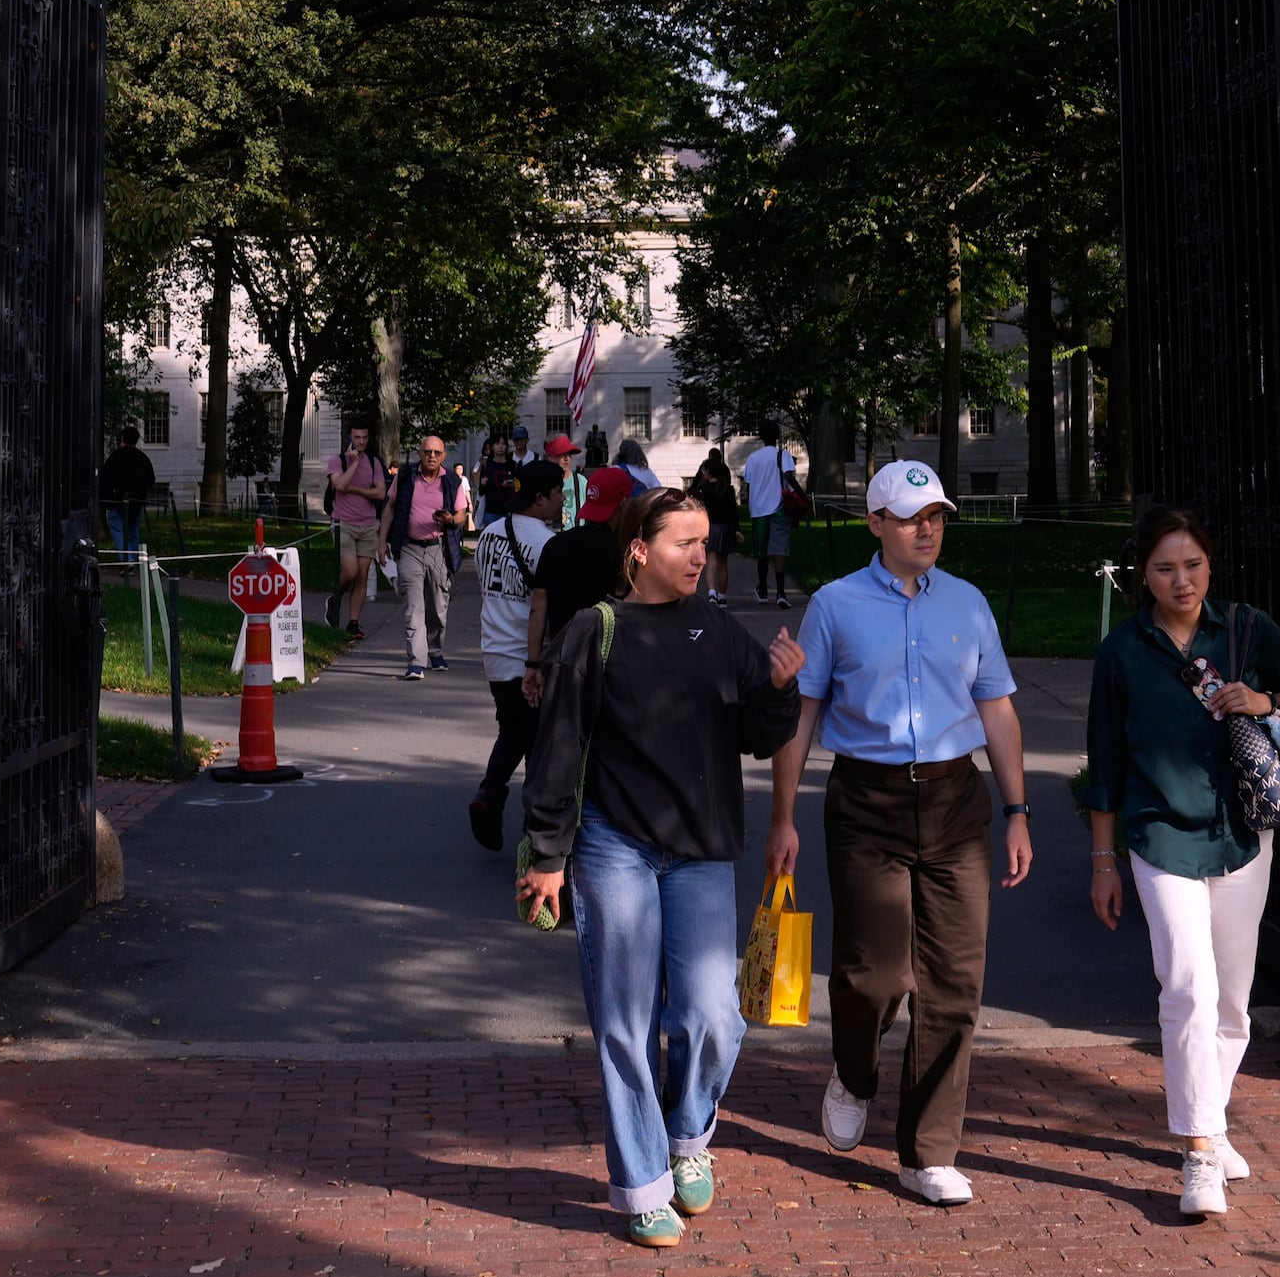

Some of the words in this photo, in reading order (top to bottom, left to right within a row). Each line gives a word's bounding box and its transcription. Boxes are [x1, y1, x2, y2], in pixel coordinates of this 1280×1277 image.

[232, 574, 286, 596] STOP
[283, 610, 299, 618] VEHICLES
[278, 623, 291, 631] PLEASE
[284, 635, 293, 643] GATE
[279, 647, 298, 655] ATTENDANT
